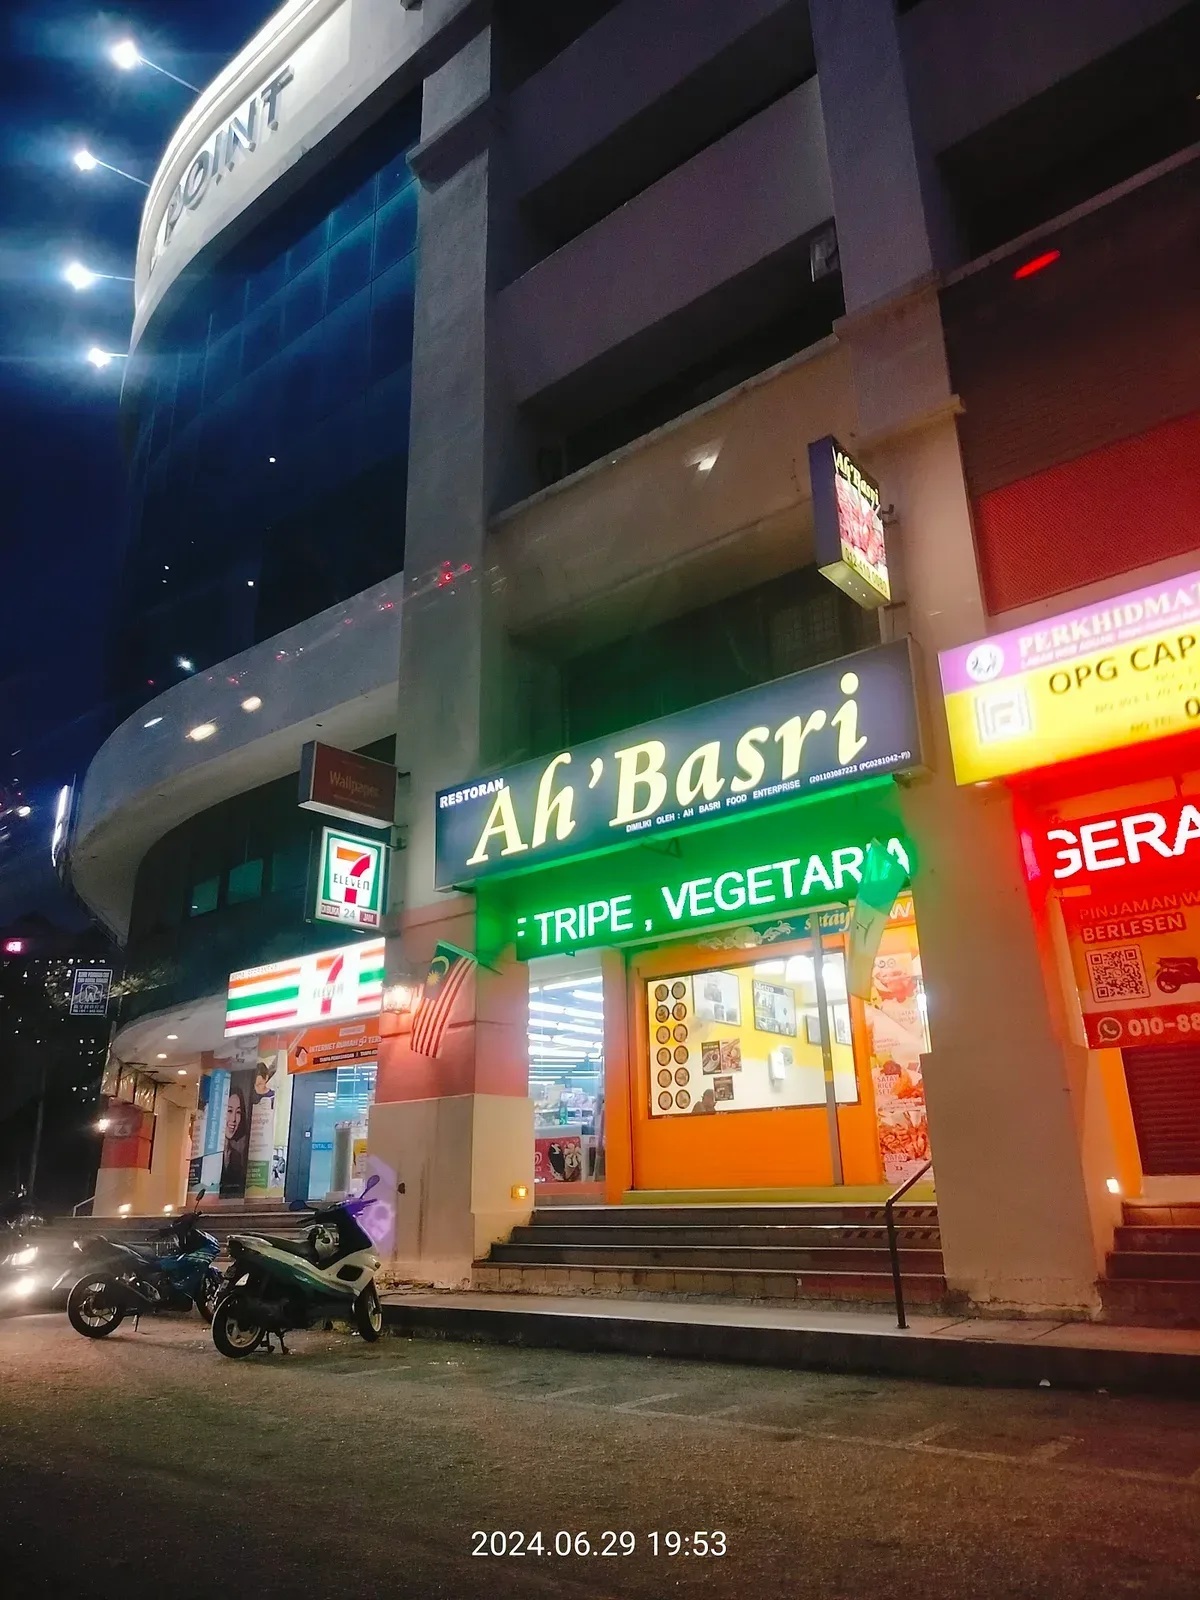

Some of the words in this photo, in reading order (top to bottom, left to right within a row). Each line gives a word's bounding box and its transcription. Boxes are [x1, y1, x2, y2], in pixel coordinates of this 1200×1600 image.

[164, 65, 294, 246] POINT
[1049, 656, 1118, 695] OPG
[1130, 634, 1197, 671] CAP
[440, 778, 504, 809] RESTORAN
[466, 672, 867, 865] Ah'Basri
[626, 819, 652, 833] DIMILIKI
[656, 813, 675, 825] OLEH
[683, 808, 694, 818] AH
[699, 800, 721, 814] BASRI
[726, 794, 747, 806] FOOD
[753, 779, 801, 799] ENTERPRISE
[1047, 804, 1200, 879] GERA
[344, 908, 356, 919] 24
[533, 895, 633, 945] TRIPE
[661, 837, 910, 920] VEGETARA
[1080, 894, 1178, 920] PINJAMAN
[1083, 914, 1183, 941] BERLESEN
